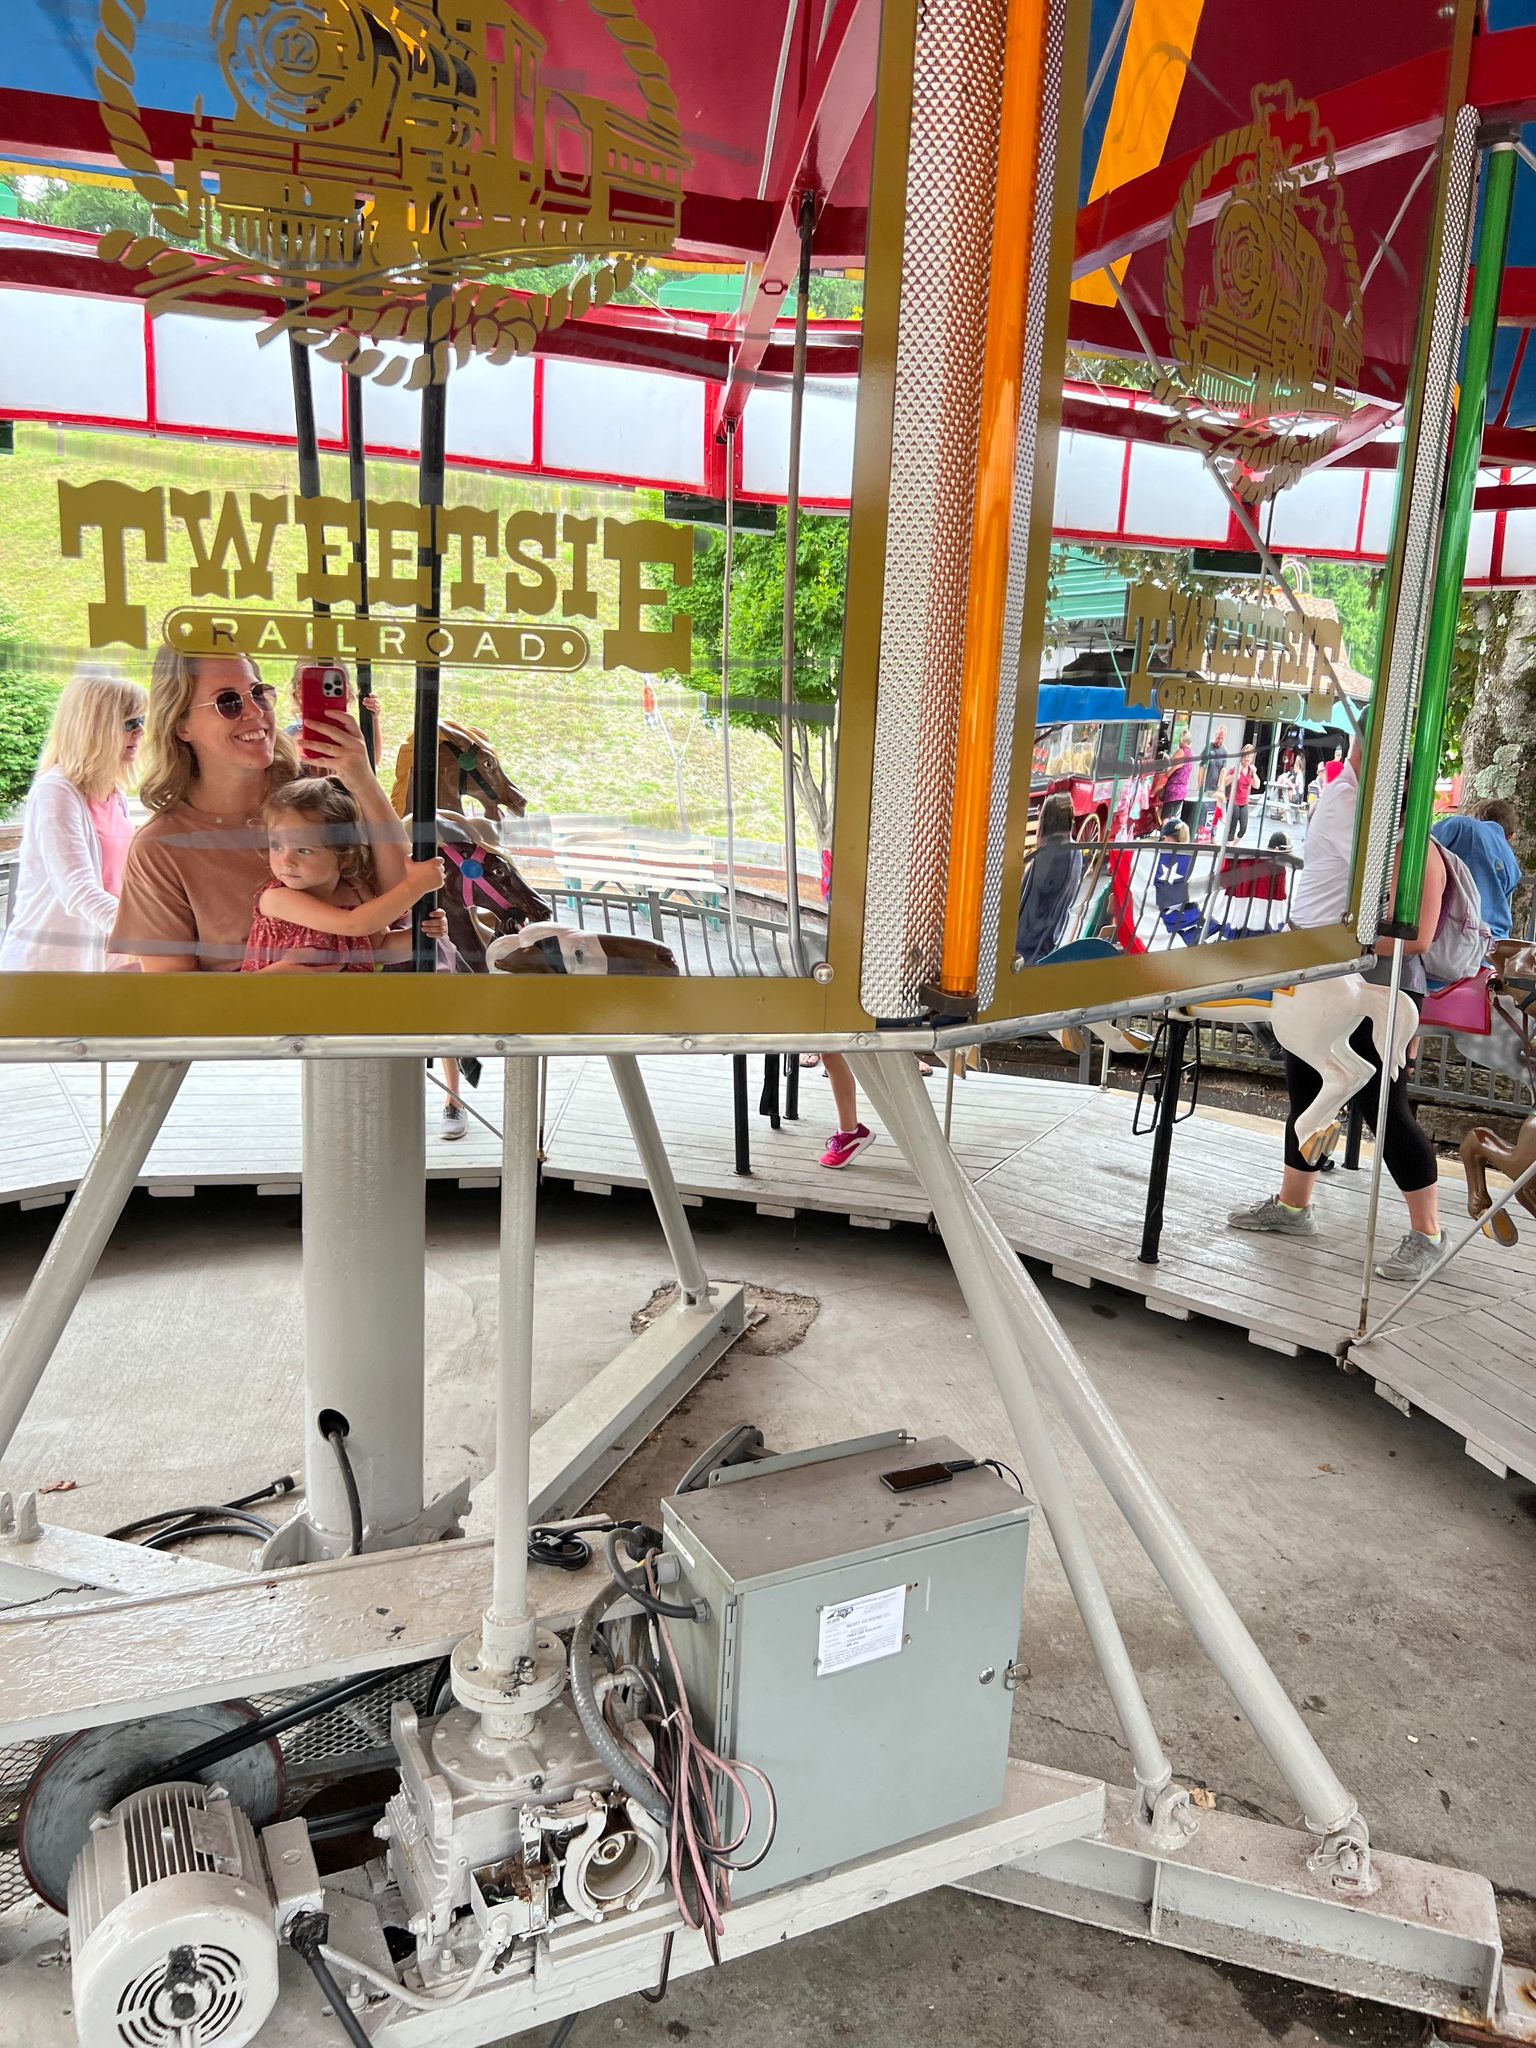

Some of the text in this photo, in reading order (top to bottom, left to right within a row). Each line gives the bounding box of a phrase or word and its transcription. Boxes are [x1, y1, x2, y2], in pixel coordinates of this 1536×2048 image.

[279, 33, 314, 67] 12
[57, 479, 695, 674] TWEETSIE
[210, 617, 546, 661] RAILROAD
